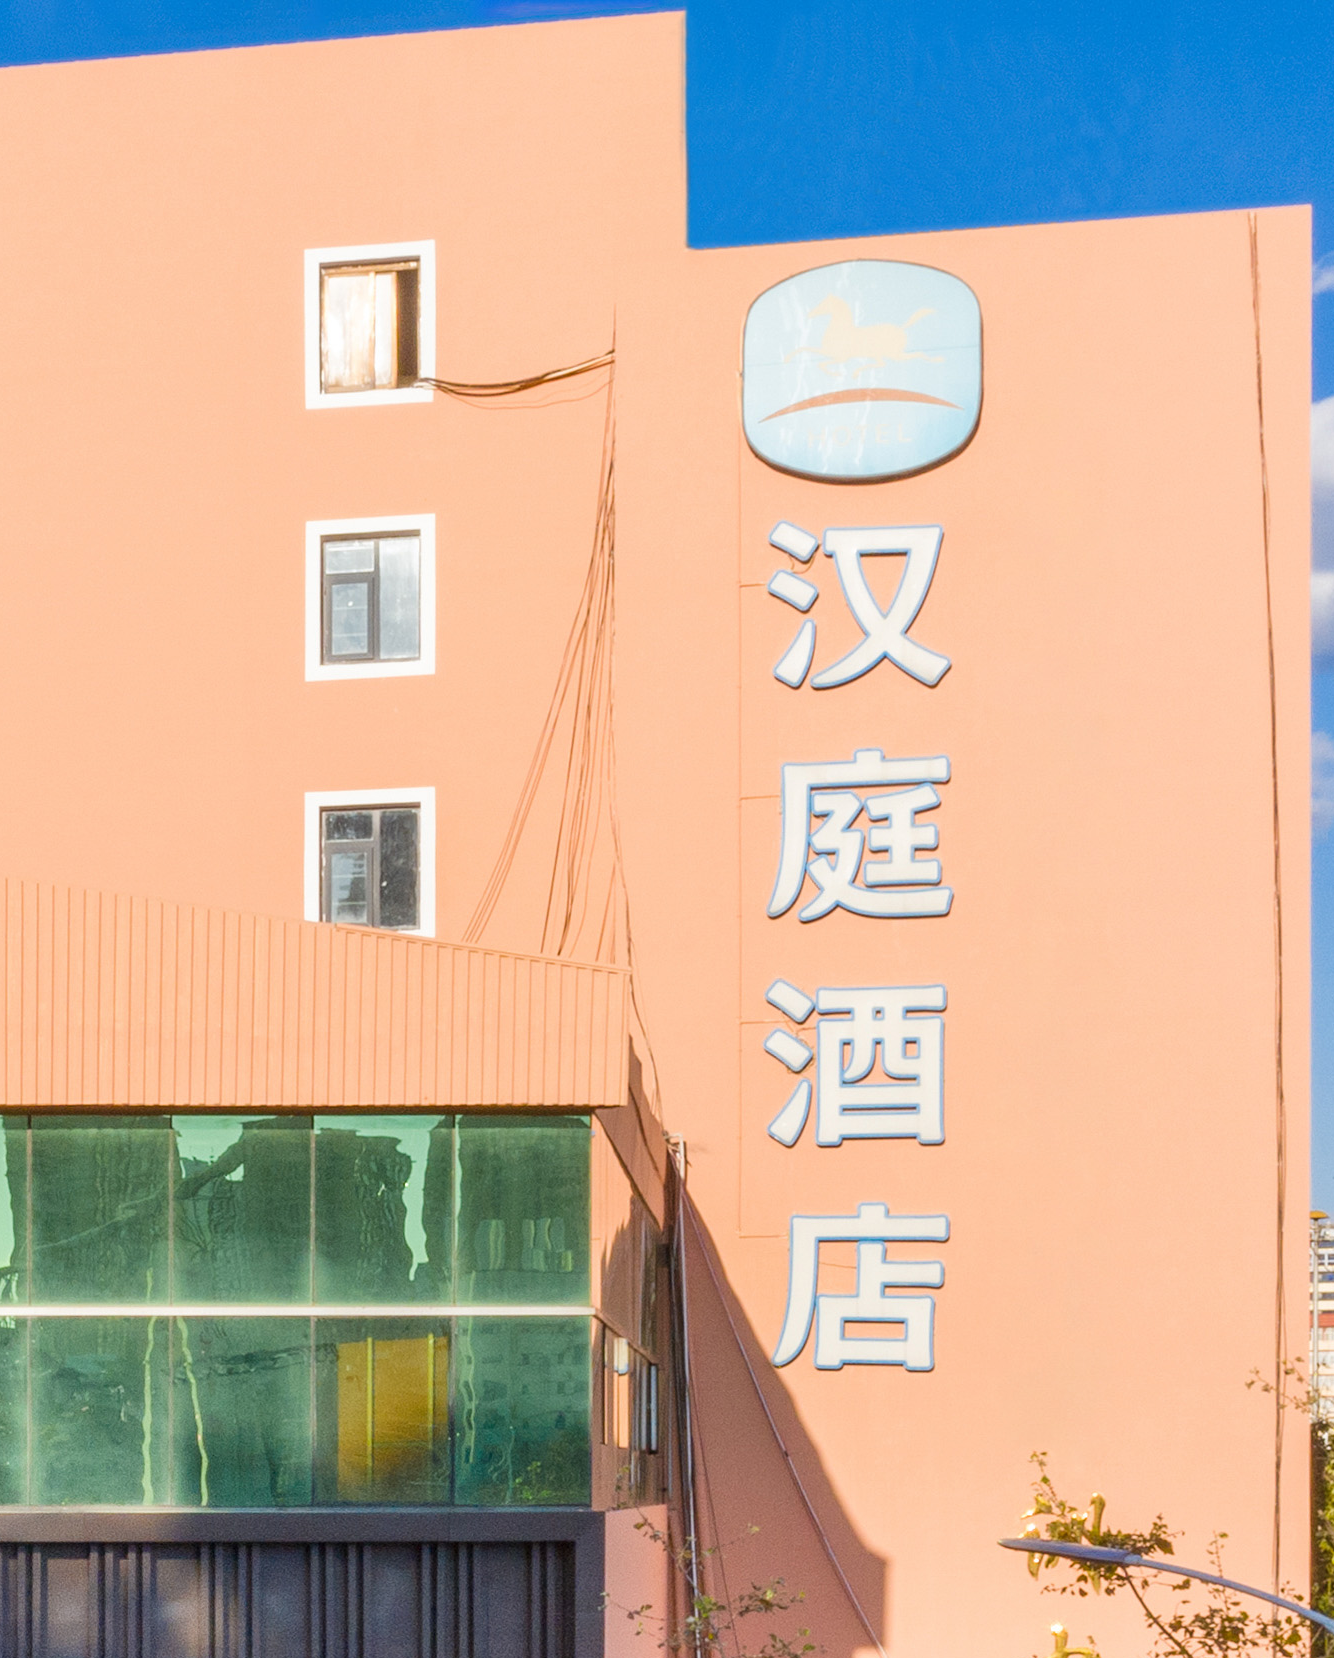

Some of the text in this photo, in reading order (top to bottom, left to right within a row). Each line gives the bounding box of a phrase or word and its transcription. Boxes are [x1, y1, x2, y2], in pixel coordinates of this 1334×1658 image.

[806, 421, 914, 448] HOTEL
[764, 517, 954, 1373] 汉庭酒店
